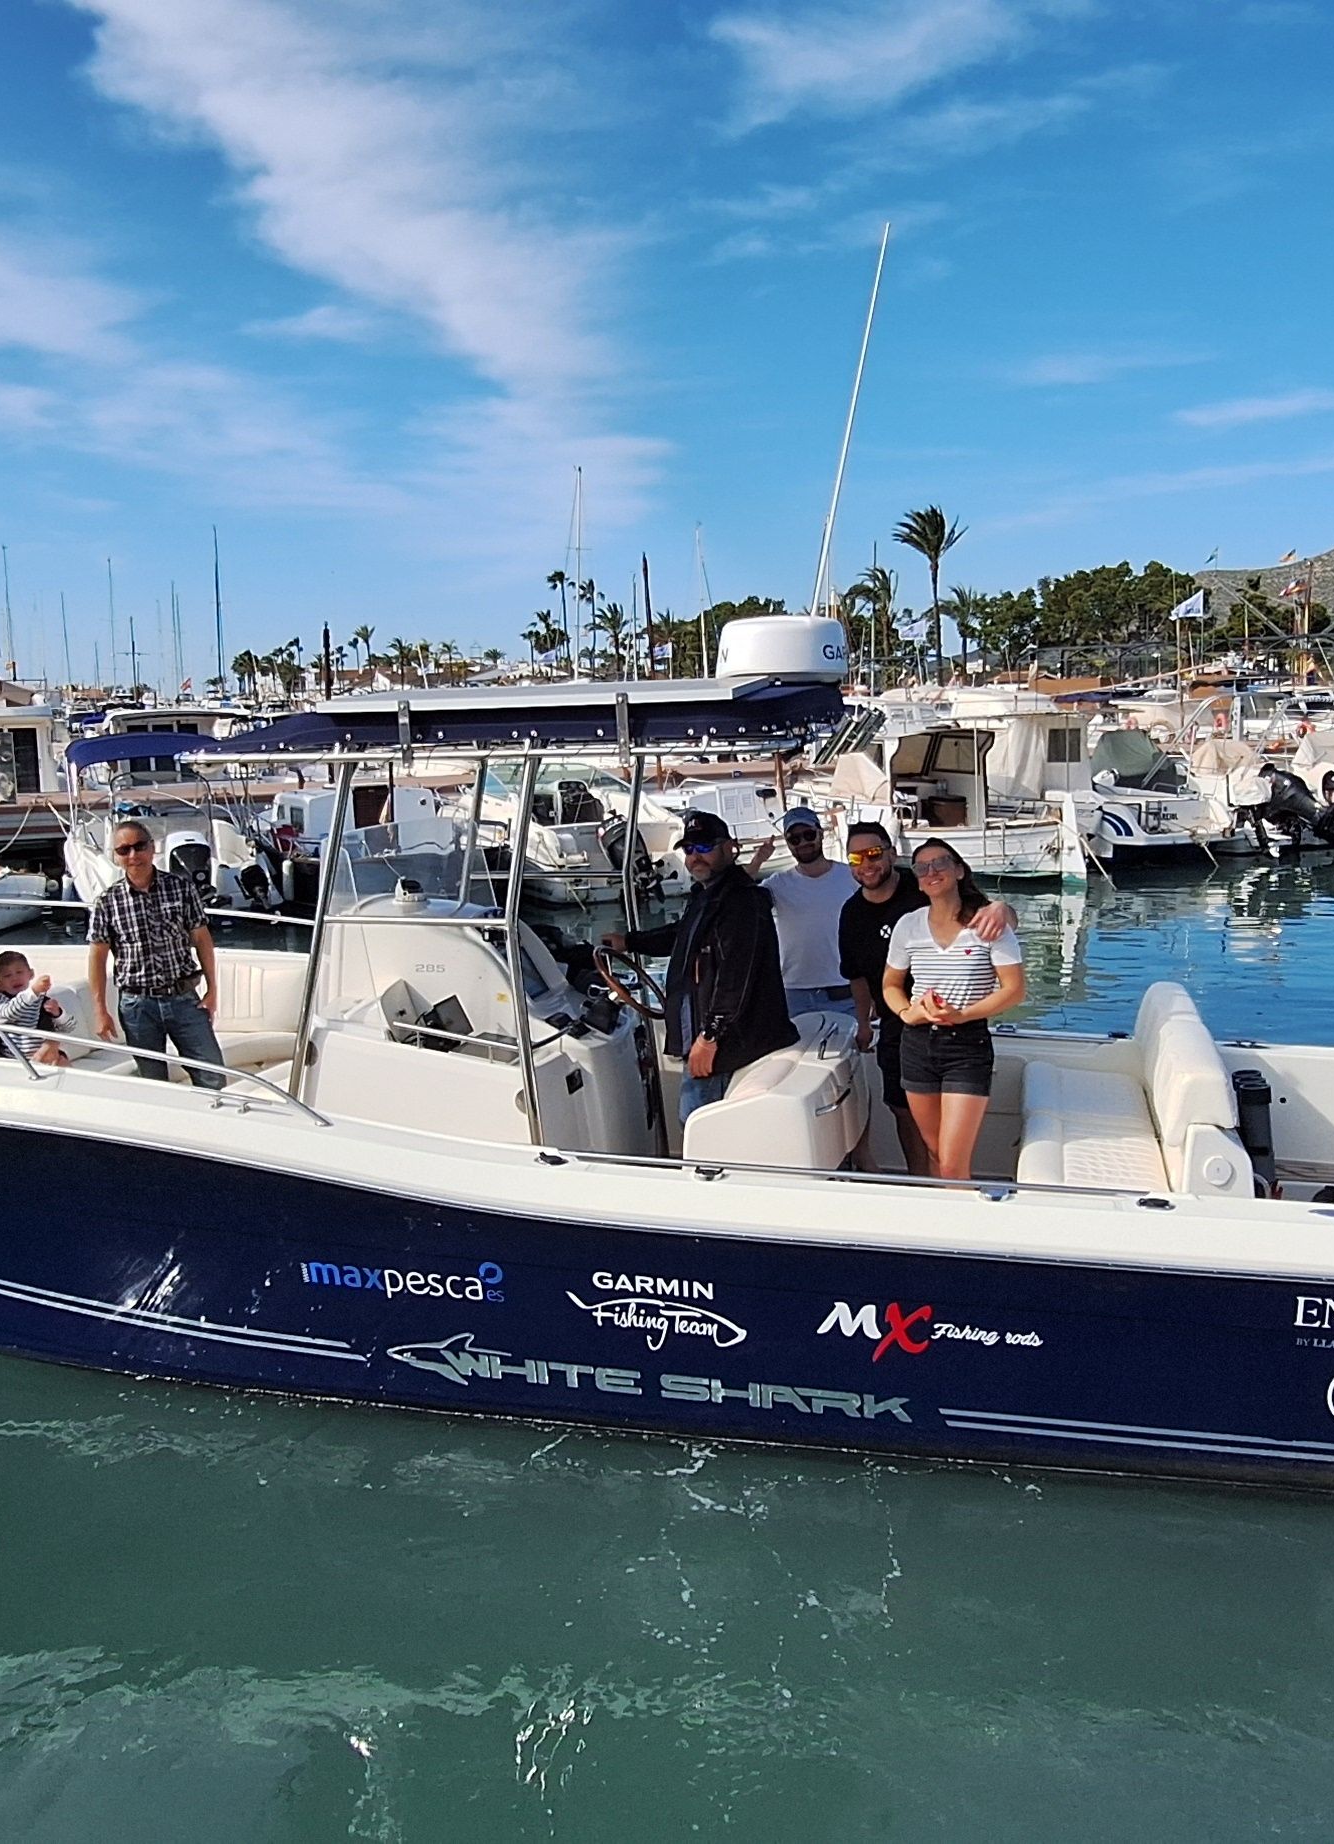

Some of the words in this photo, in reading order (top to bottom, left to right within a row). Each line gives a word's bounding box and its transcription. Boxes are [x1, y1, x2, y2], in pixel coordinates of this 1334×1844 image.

[414, 963, 446, 974] 285
[592, 1271, 714, 1300] GARMIN
[592, 1302, 668, 1351] Fishing
[659, 1308, 719, 1338] Team
[816, 1301, 933, 1362] MX
[930, 1323, 1001, 1346] Fishing
[1004, 1331, 1044, 1347] rods
[1295, 1337, 1310, 1347] BY
[440, 1349, 643, 1395] WHITE
[660, 1373, 913, 1424] SHARK
